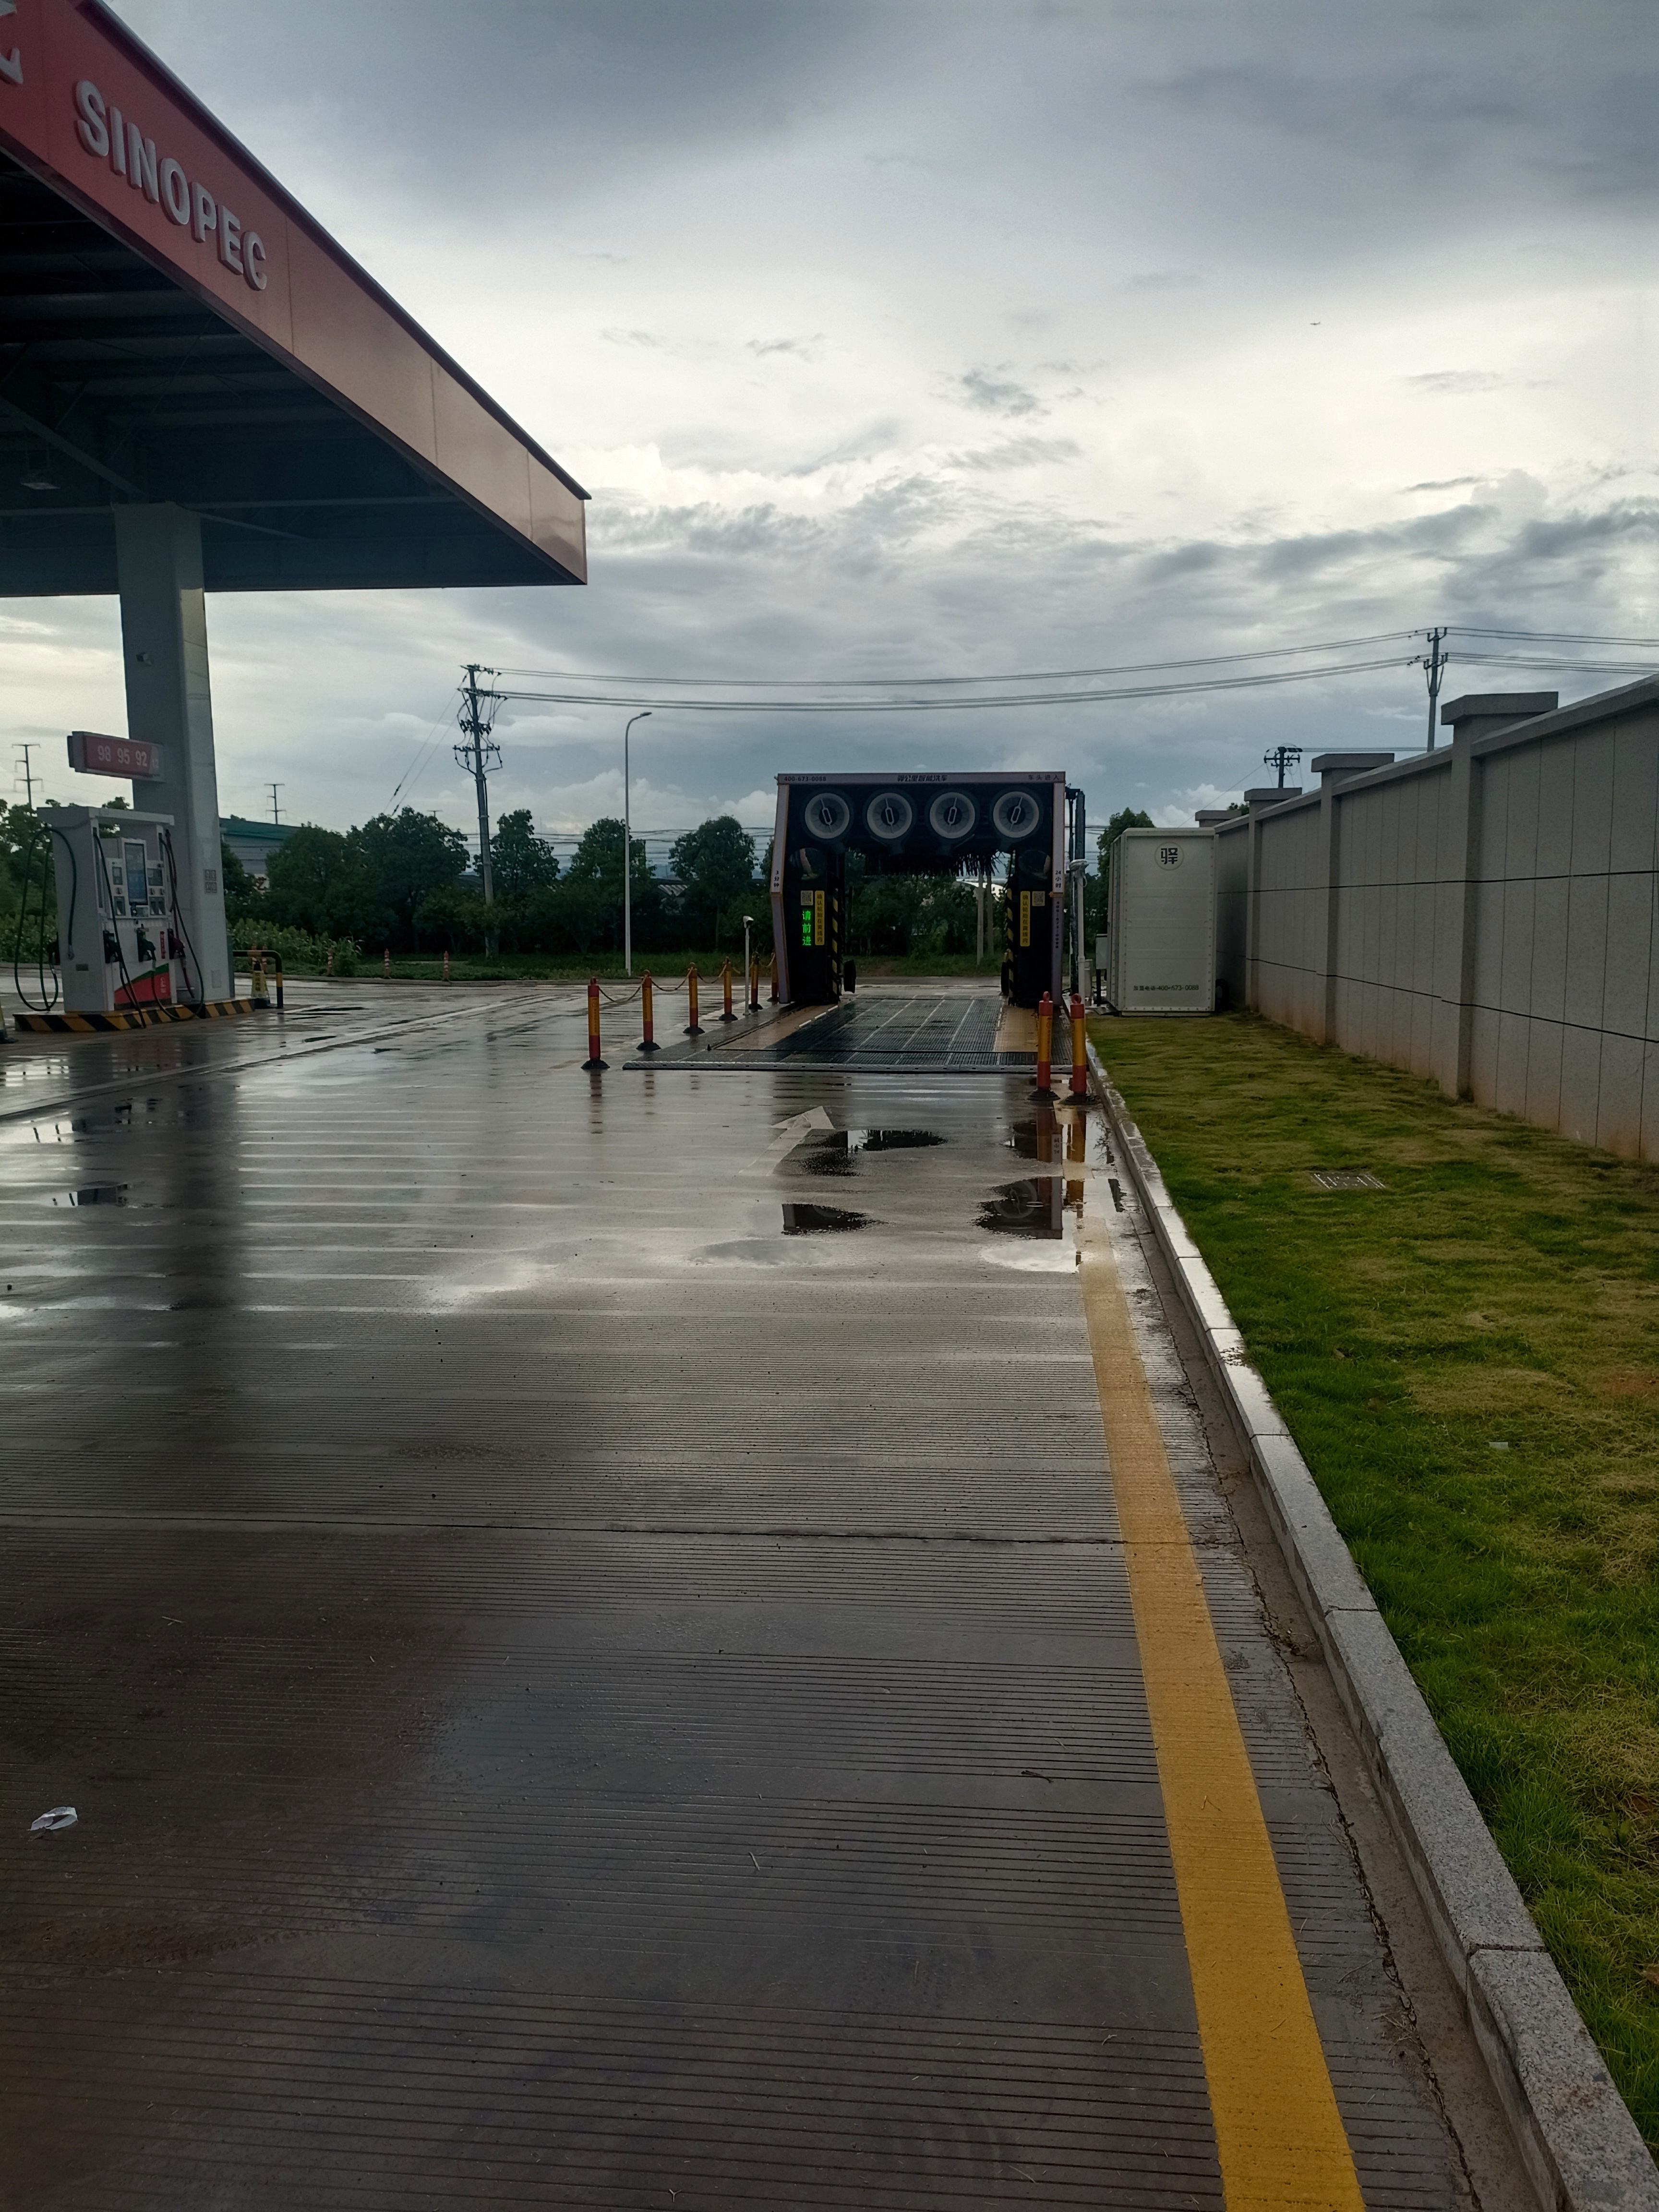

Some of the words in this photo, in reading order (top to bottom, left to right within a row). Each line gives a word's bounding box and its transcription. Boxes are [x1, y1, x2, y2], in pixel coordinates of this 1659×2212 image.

[74, 79, 267, 290] SINOPEC
[97, 745, 111, 762] 98
[117, 748, 131, 764] 95
[135, 750, 148, 767] 92
[1160, 847, 1178, 865] 驿
[802, 910, 812, 946] 请前进
